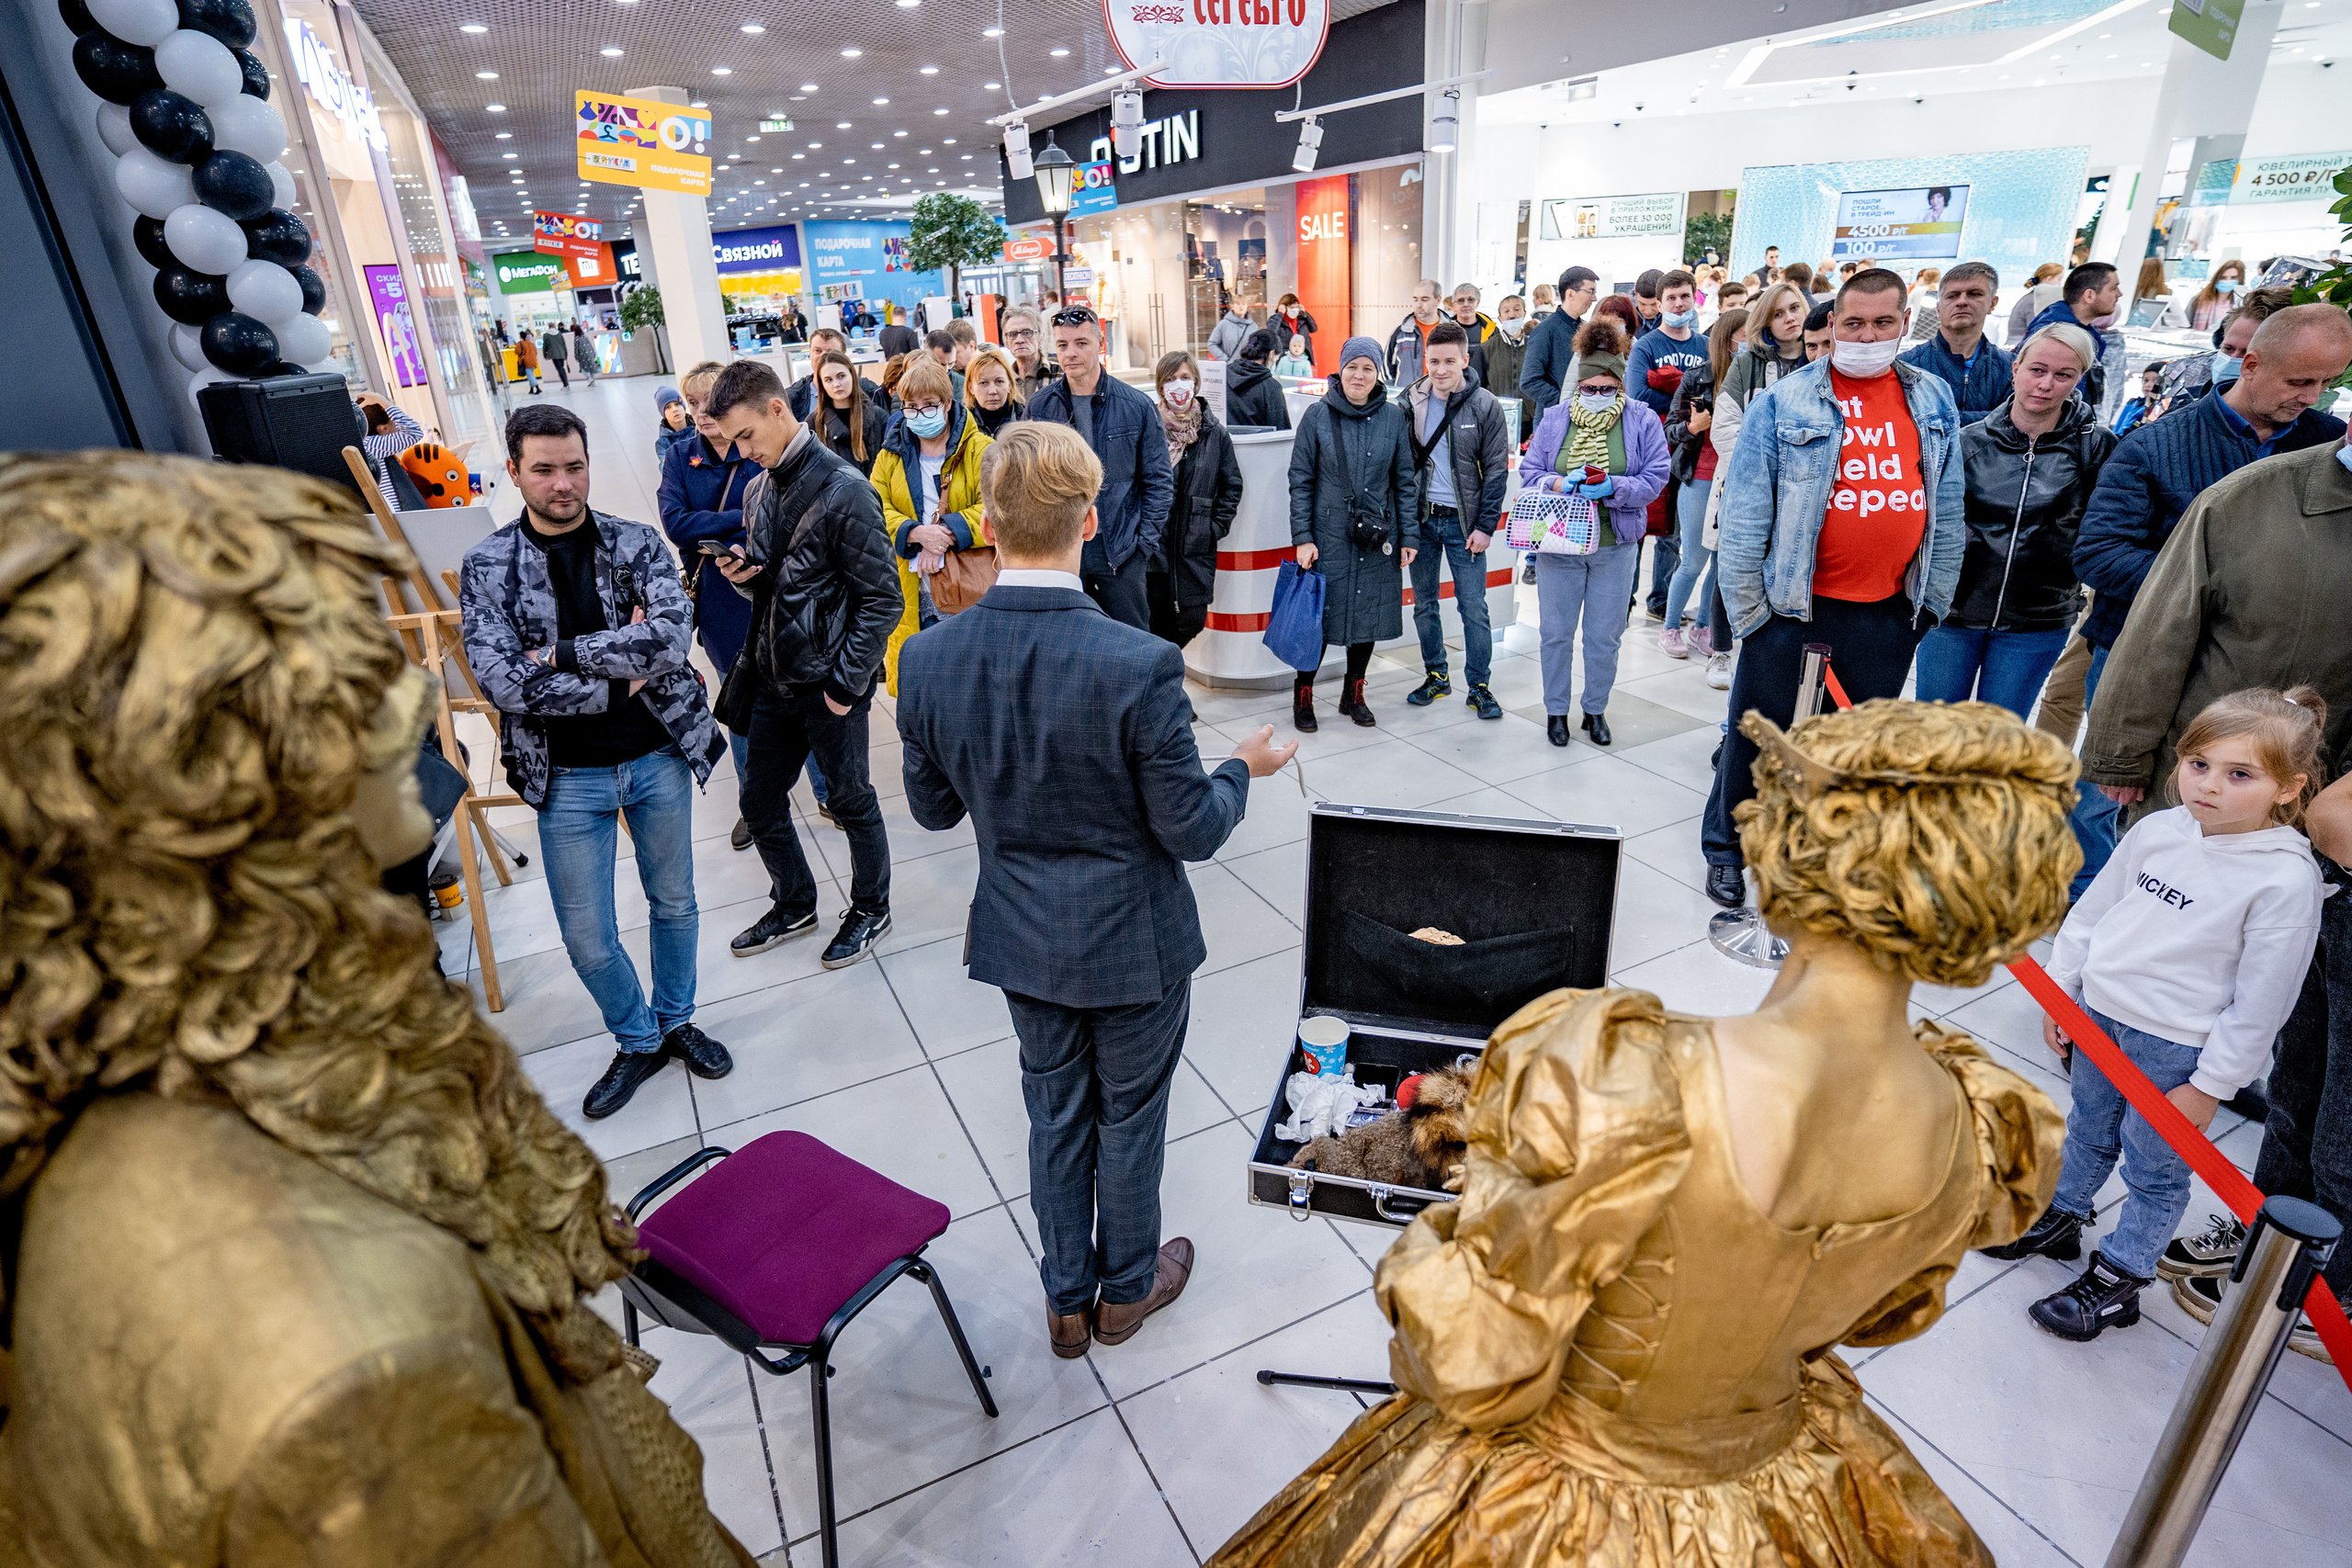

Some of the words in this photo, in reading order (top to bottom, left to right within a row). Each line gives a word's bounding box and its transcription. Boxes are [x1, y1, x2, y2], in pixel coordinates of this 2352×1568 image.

[2257, 154, 2344, 172] ЮВЕЛИРНЫЙ
[650, 164, 706, 178] ПОДАРОЧНАЯ
[680, 176, 706, 186] КАРТА
[2252, 175, 2262, 186] 4
[2266, 172, 2300, 186] 500
[2249, 186, 2311, 197] ГАРАНТИЯ
[2314, 186, 2335, 195] ЛУ
[1611, 198, 1645, 207] ЛУЧШИЙ
[1646, 197, 1675, 206] ВЫБОР
[1618, 205, 1674, 213] ПРИЛОЖЕНИИ
[1610, 215, 1638, 223] БОЛЕЕ
[1641, 214, 1652, 222] 30
[1654, 213, 1673, 221] 000
[1300, 211, 1344, 241] SALE
[1614, 221, 1672, 233] УКРАШЕНИЙ
[1848, 224, 1891, 238] 4500
[814, 238, 872, 250] ПОДАРОЧНАЯ
[1846, 242, 1876, 254] 100
[817, 255, 845, 267] КАРТА
[1825, 485, 1927, 517] epea
